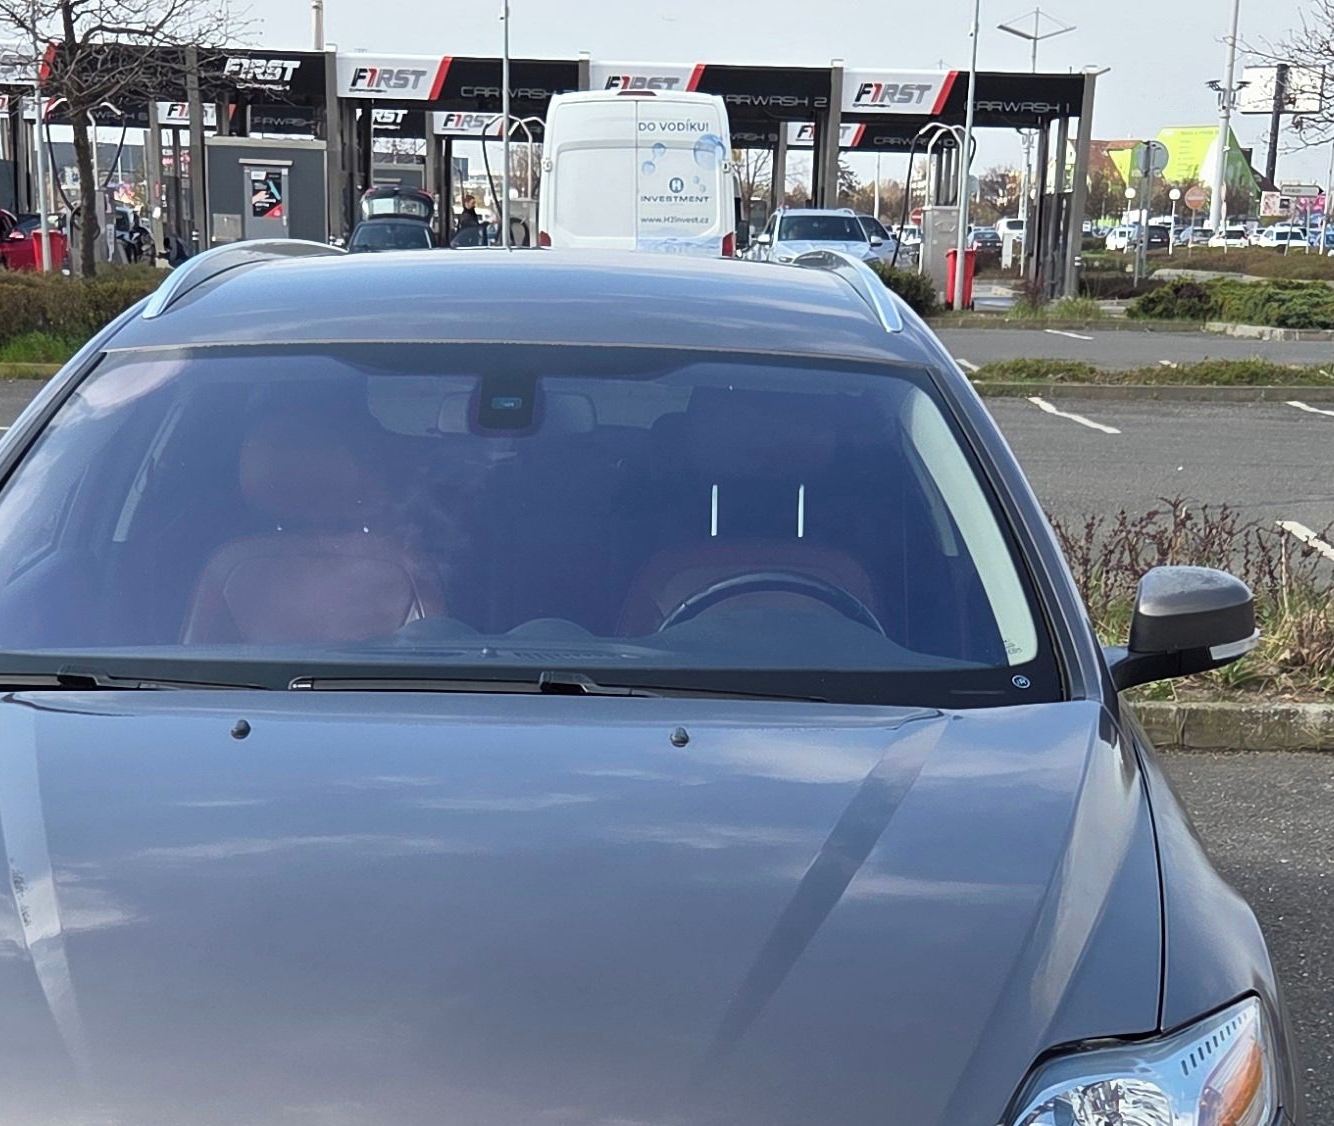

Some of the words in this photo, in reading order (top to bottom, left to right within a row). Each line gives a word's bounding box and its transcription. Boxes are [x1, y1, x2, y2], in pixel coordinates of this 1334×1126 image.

[725, 94, 809, 106] ARWASH
[814, 96, 828, 107] 2
[638, 122, 656, 132] DO
[659, 118, 709, 132] VODÍKU!
[640, 195, 710, 203] INVESTMENT
